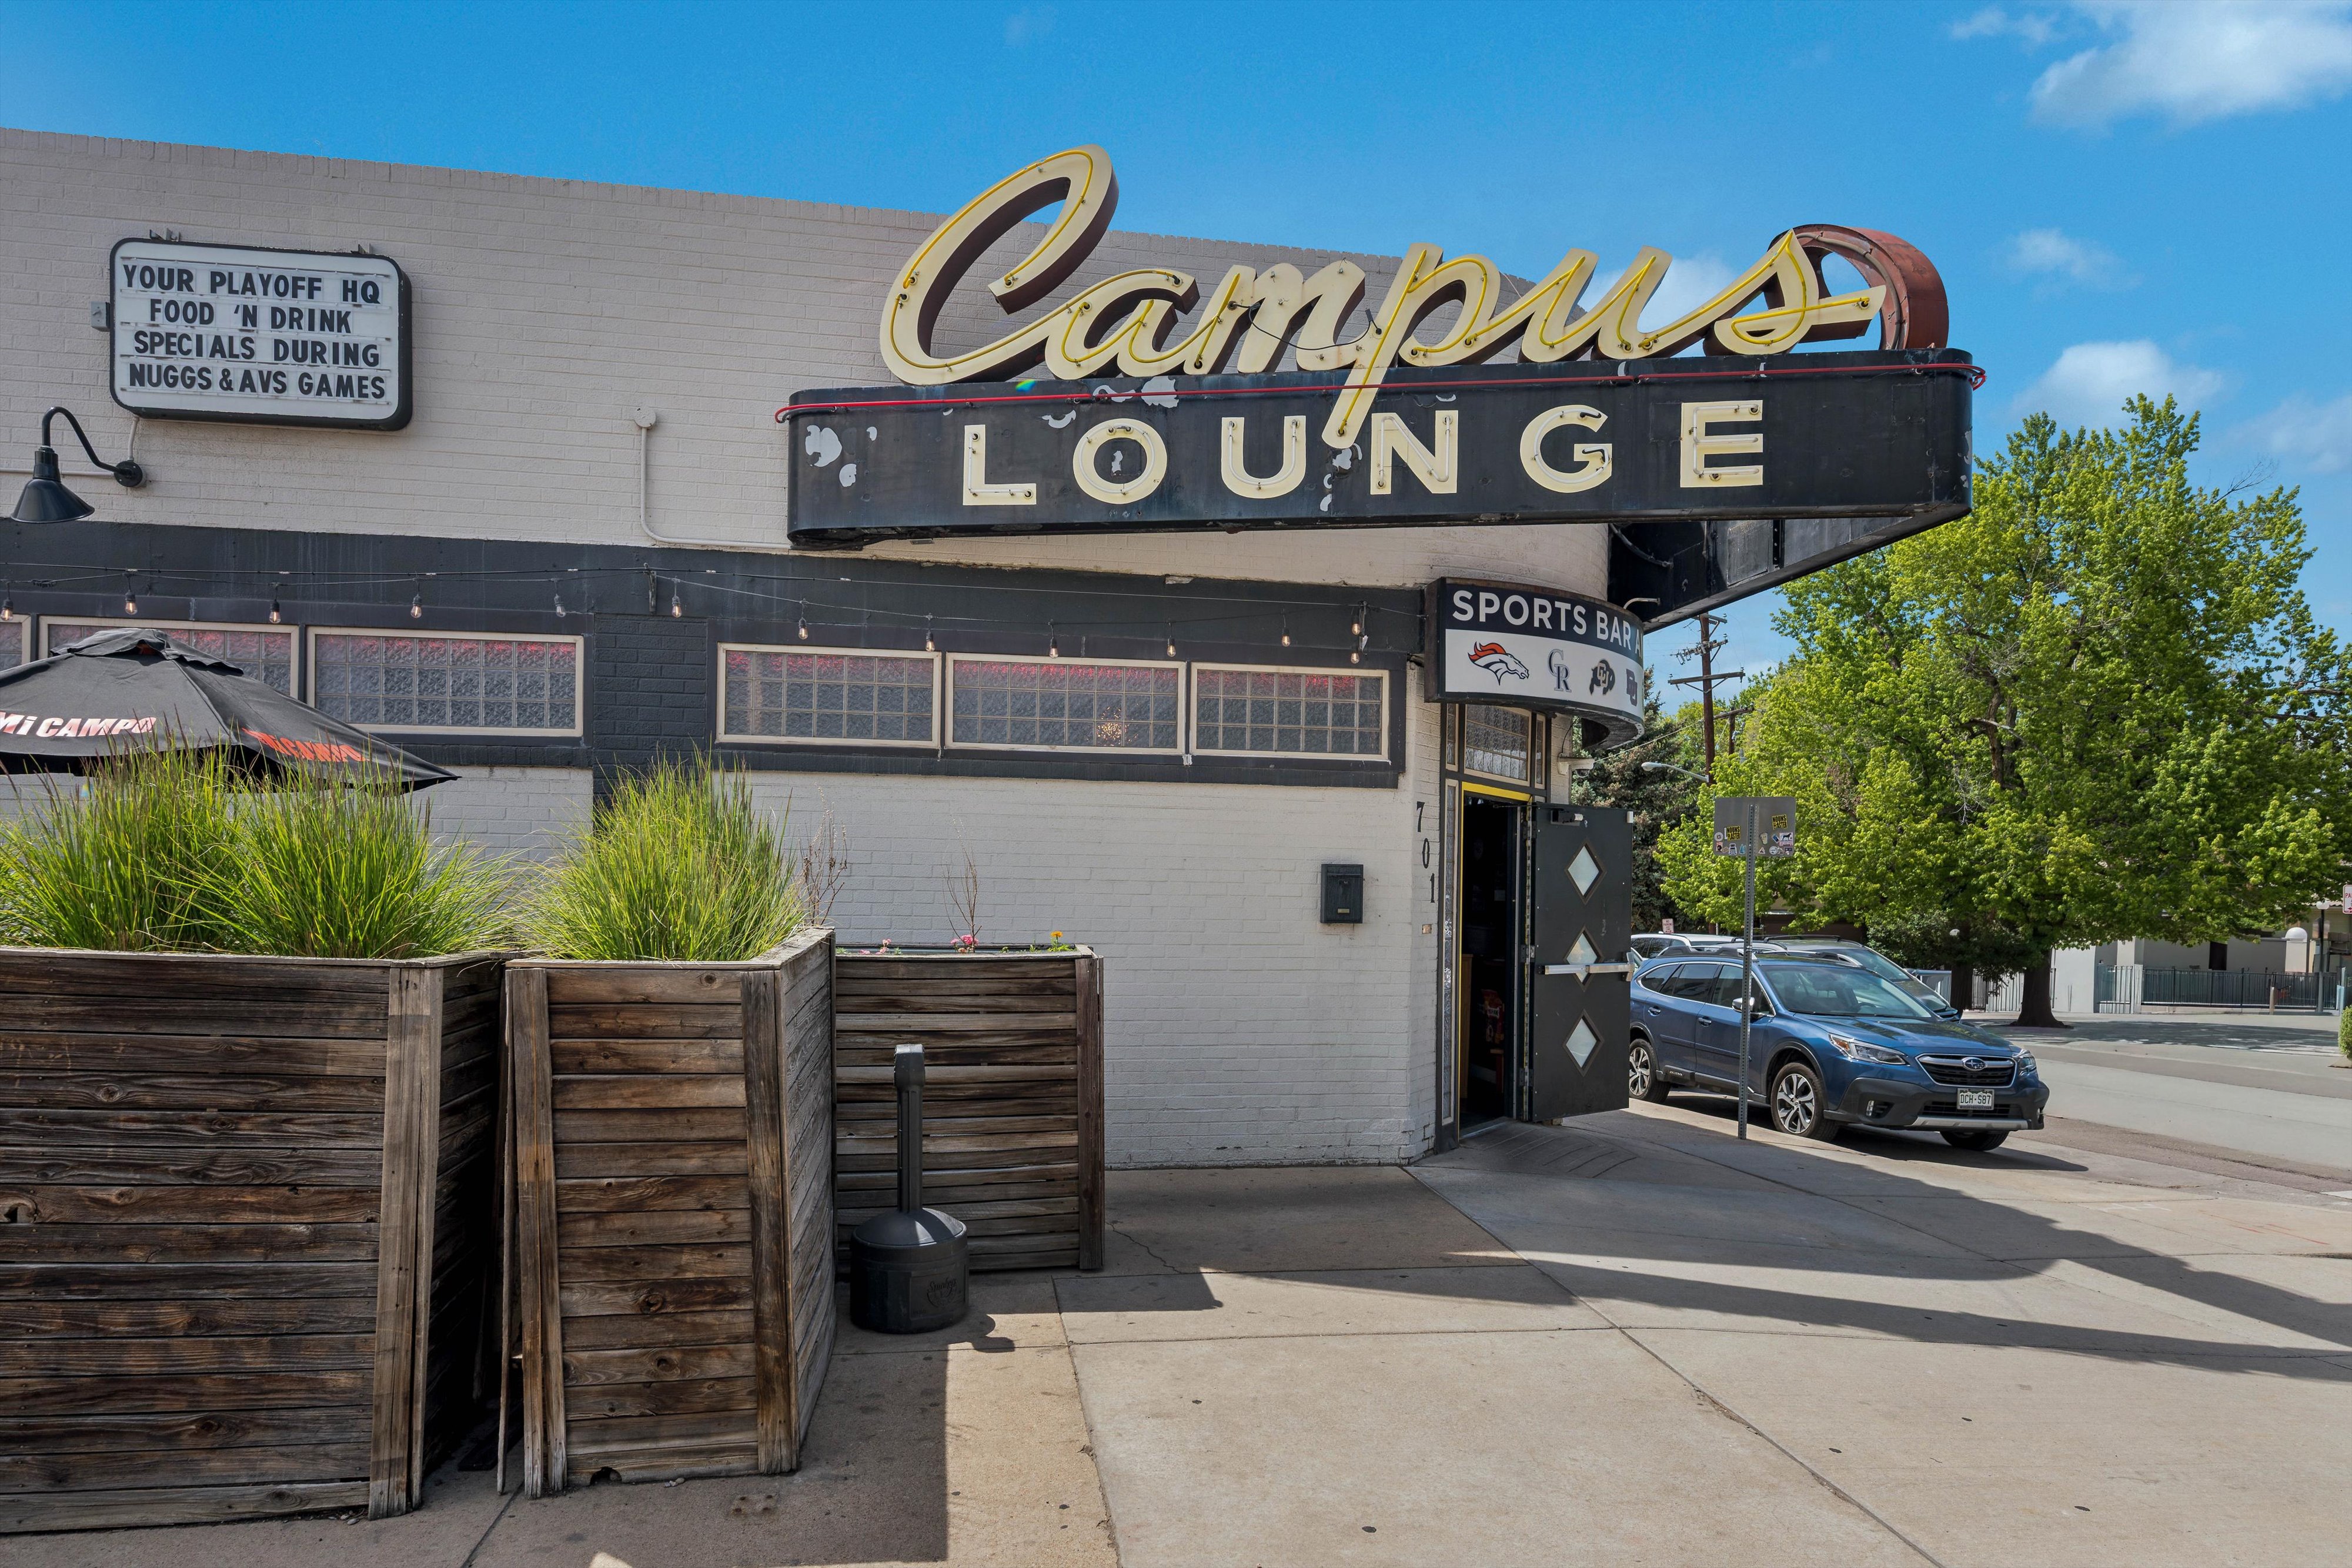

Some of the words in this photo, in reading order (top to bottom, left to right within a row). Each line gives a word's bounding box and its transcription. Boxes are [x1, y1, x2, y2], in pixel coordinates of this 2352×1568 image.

[123, 265, 194, 292] YOUR
[210, 271, 322, 300] PLAYOFF
[342, 279, 381, 304] HQ
[880, 144, 1886, 449] Campus
[150, 299, 214, 325] FOOD
[233, 304, 258, 327] 'N
[270, 307, 352, 333] DRINK
[134, 330, 255, 360] SPECIALS
[274, 339, 379, 367] DURING
[129, 363, 212, 390] NUGGS
[219, 369, 233, 391] &
[239, 369, 287, 394] AVS
[299, 372, 385, 399] GAMES
[963, 399, 1763, 506] LOUNGE
[1452, 590, 1587, 635] SPORTS
[1596, 610, 1632, 650] BAR
[36, 717, 157, 737] CAMPO
[1416, 801, 1435, 904] 701
